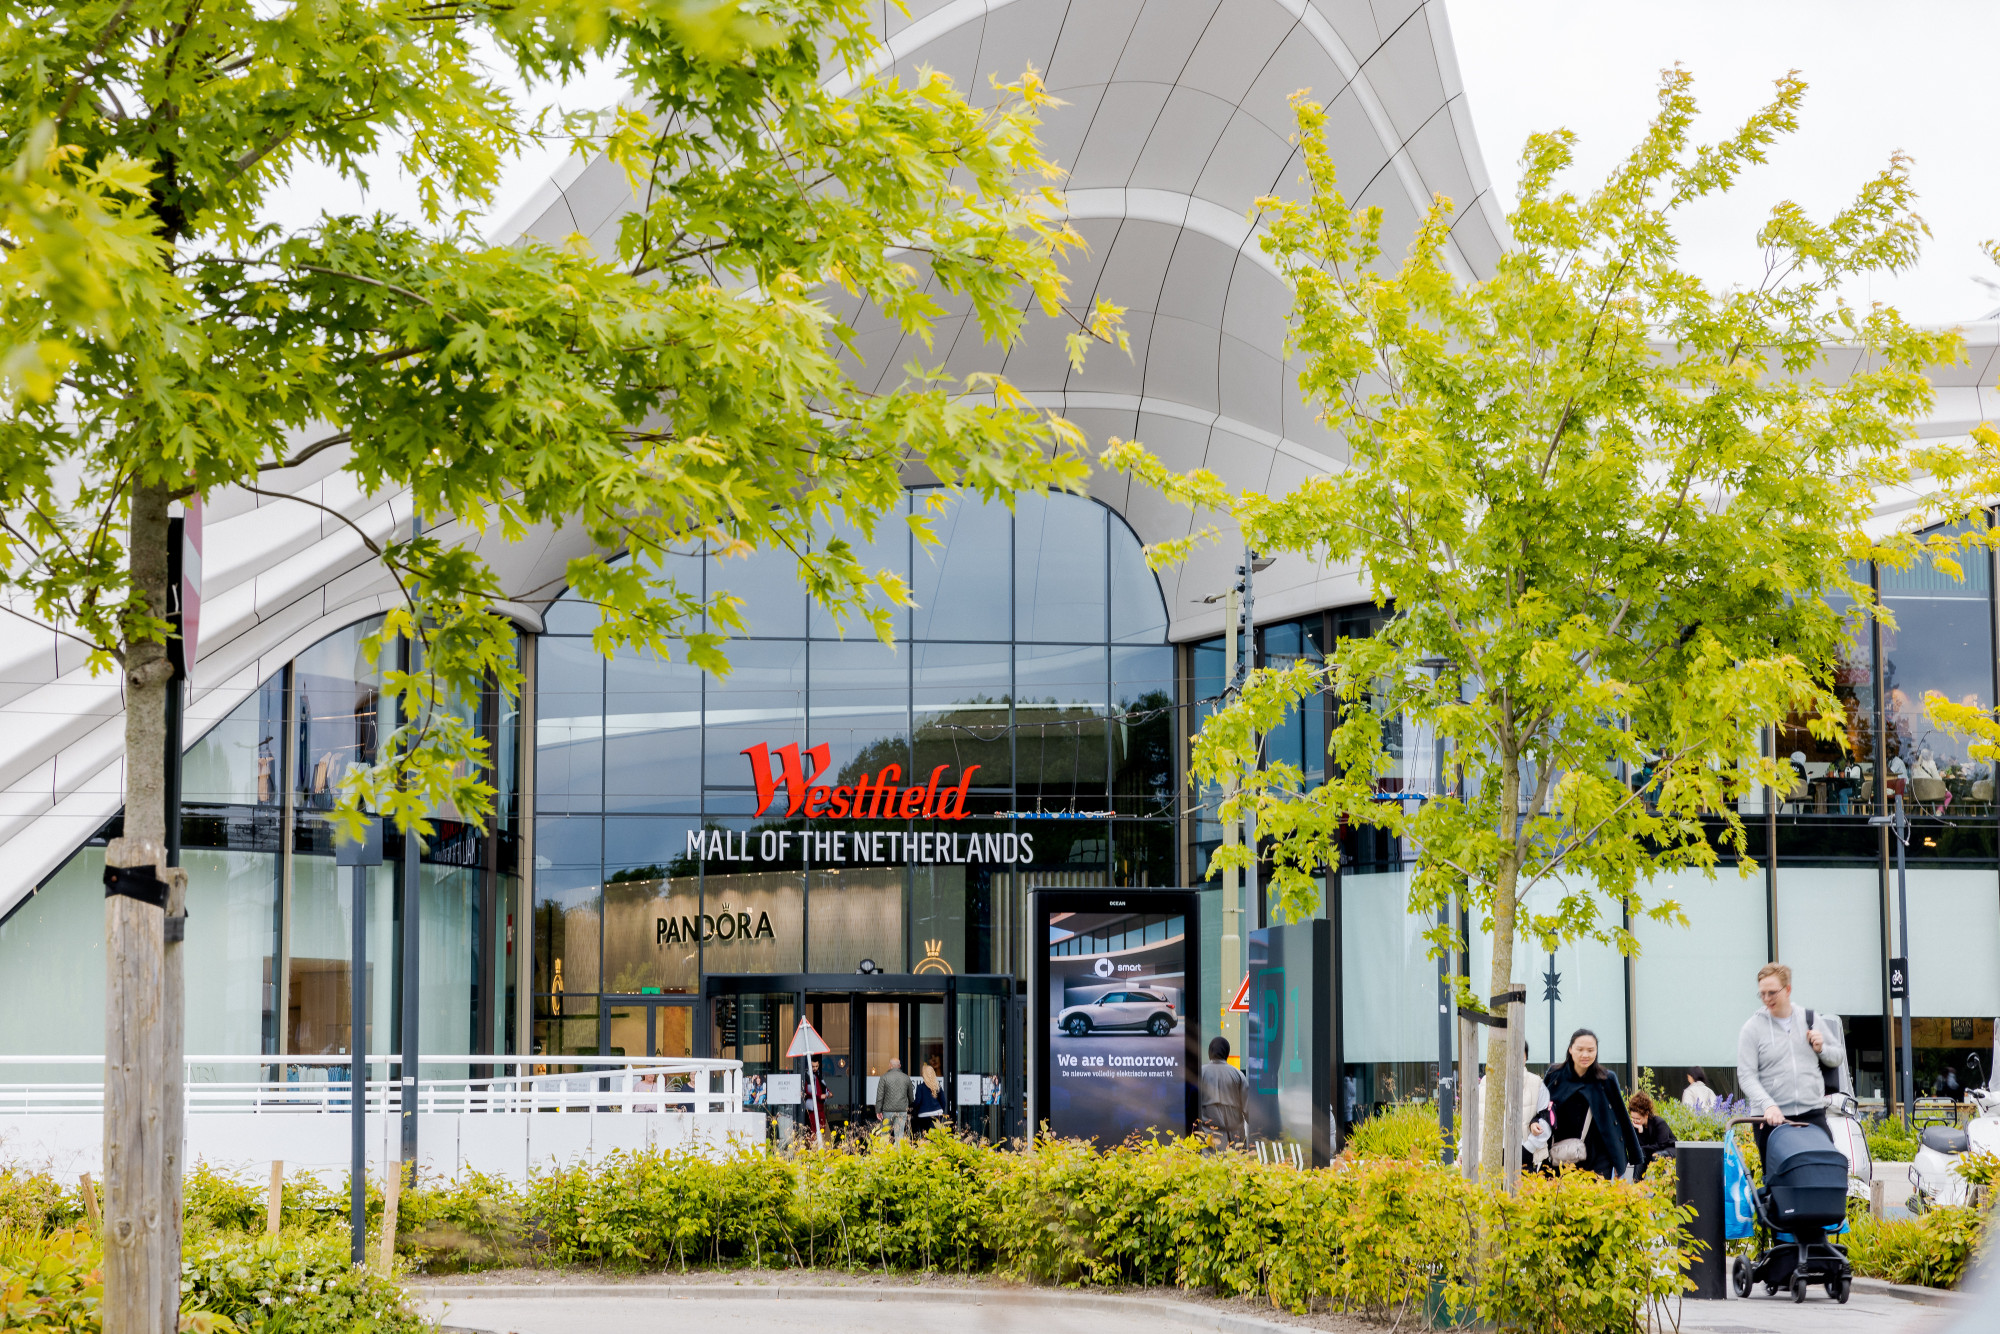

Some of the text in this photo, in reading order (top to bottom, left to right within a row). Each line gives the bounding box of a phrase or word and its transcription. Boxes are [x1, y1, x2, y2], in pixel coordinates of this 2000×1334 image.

[741, 742, 982, 821] Westfield
[686, 829, 1034, 864] MALL OF THE NETHERLANDS
[656, 911, 776, 944] PANDORA
[1117, 963, 1142, 972] smart
[1057, 1053, 1179, 1067] We are tomorrow.
[1092, 1070, 1115, 1079] volledig
